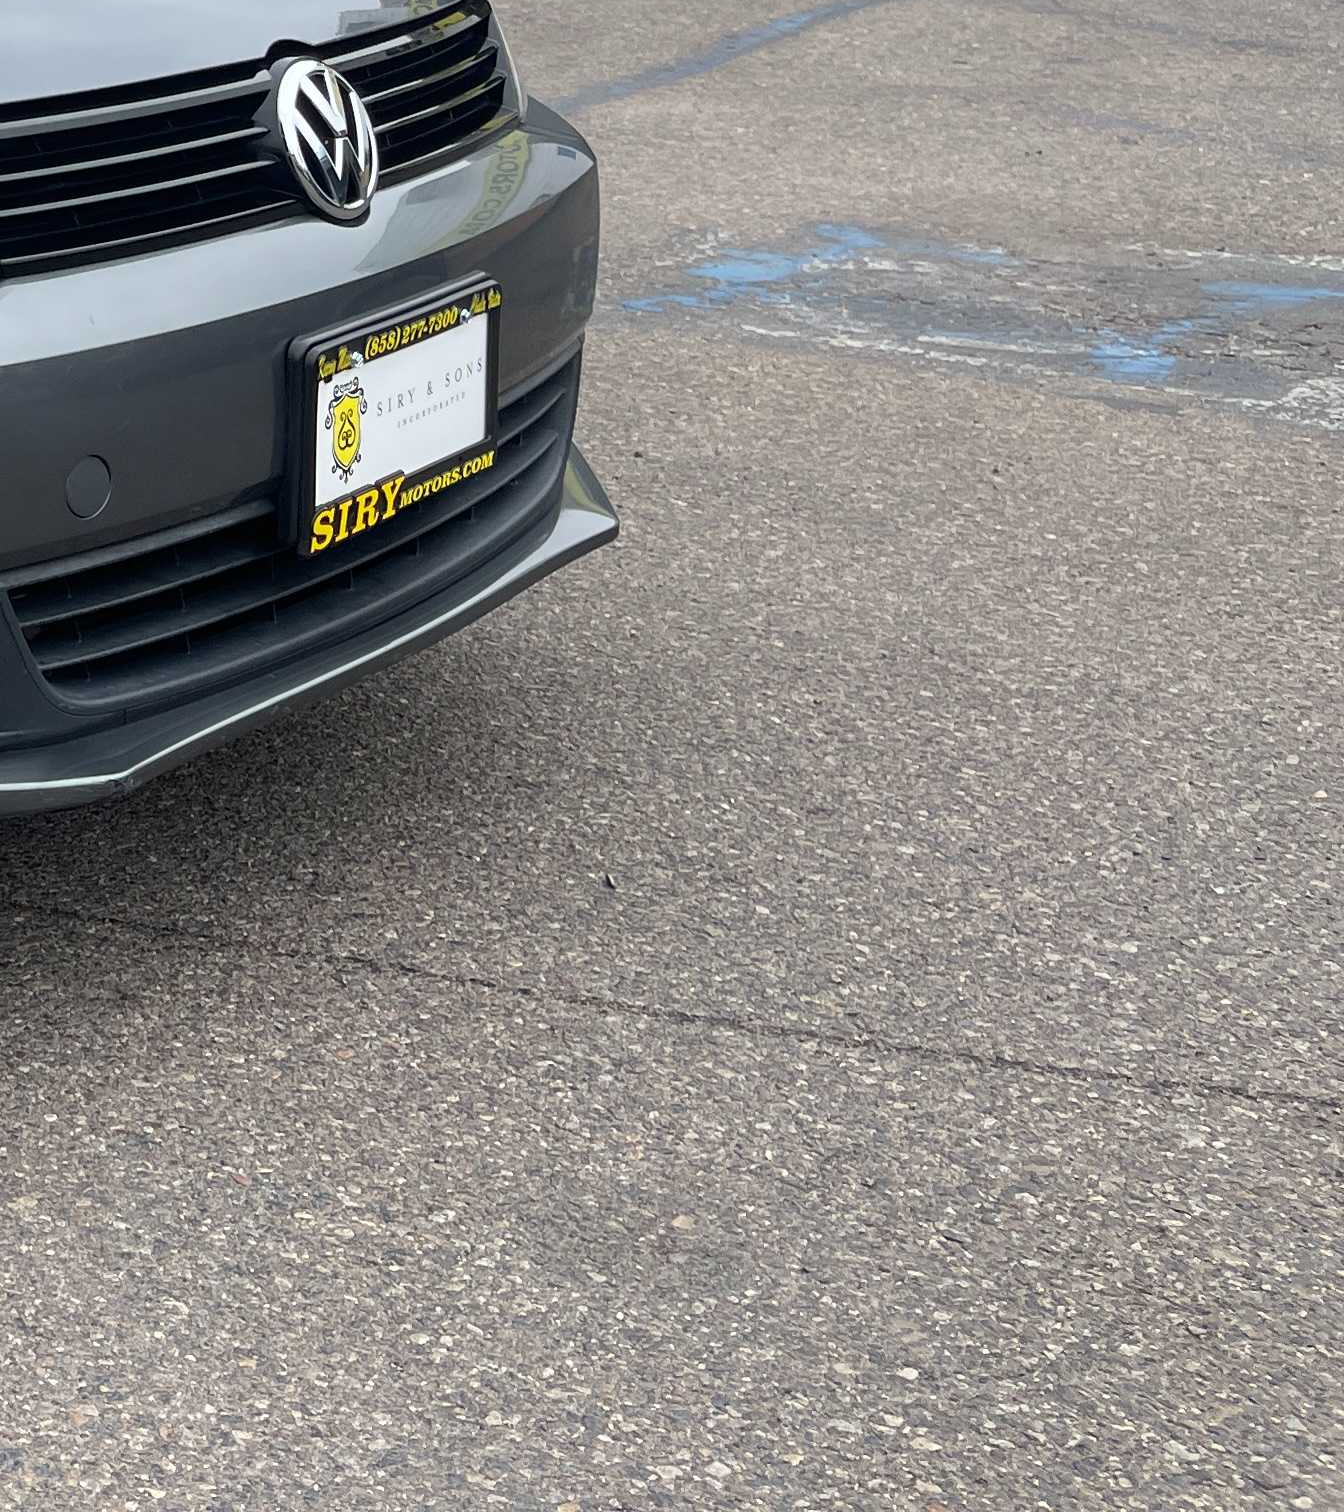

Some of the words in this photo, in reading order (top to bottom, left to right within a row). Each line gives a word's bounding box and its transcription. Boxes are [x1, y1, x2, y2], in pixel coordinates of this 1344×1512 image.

[365, 325, 401, 360] (858)
[402, 306, 458, 344] 277-7300
[376, 389, 418, 417] SIRY
[426, 381, 434, 396] &
[444, 359, 484, 387] SONS
[310, 475, 407, 554] SIRY
[399, 451, 495, 509] MOTORS.COM
